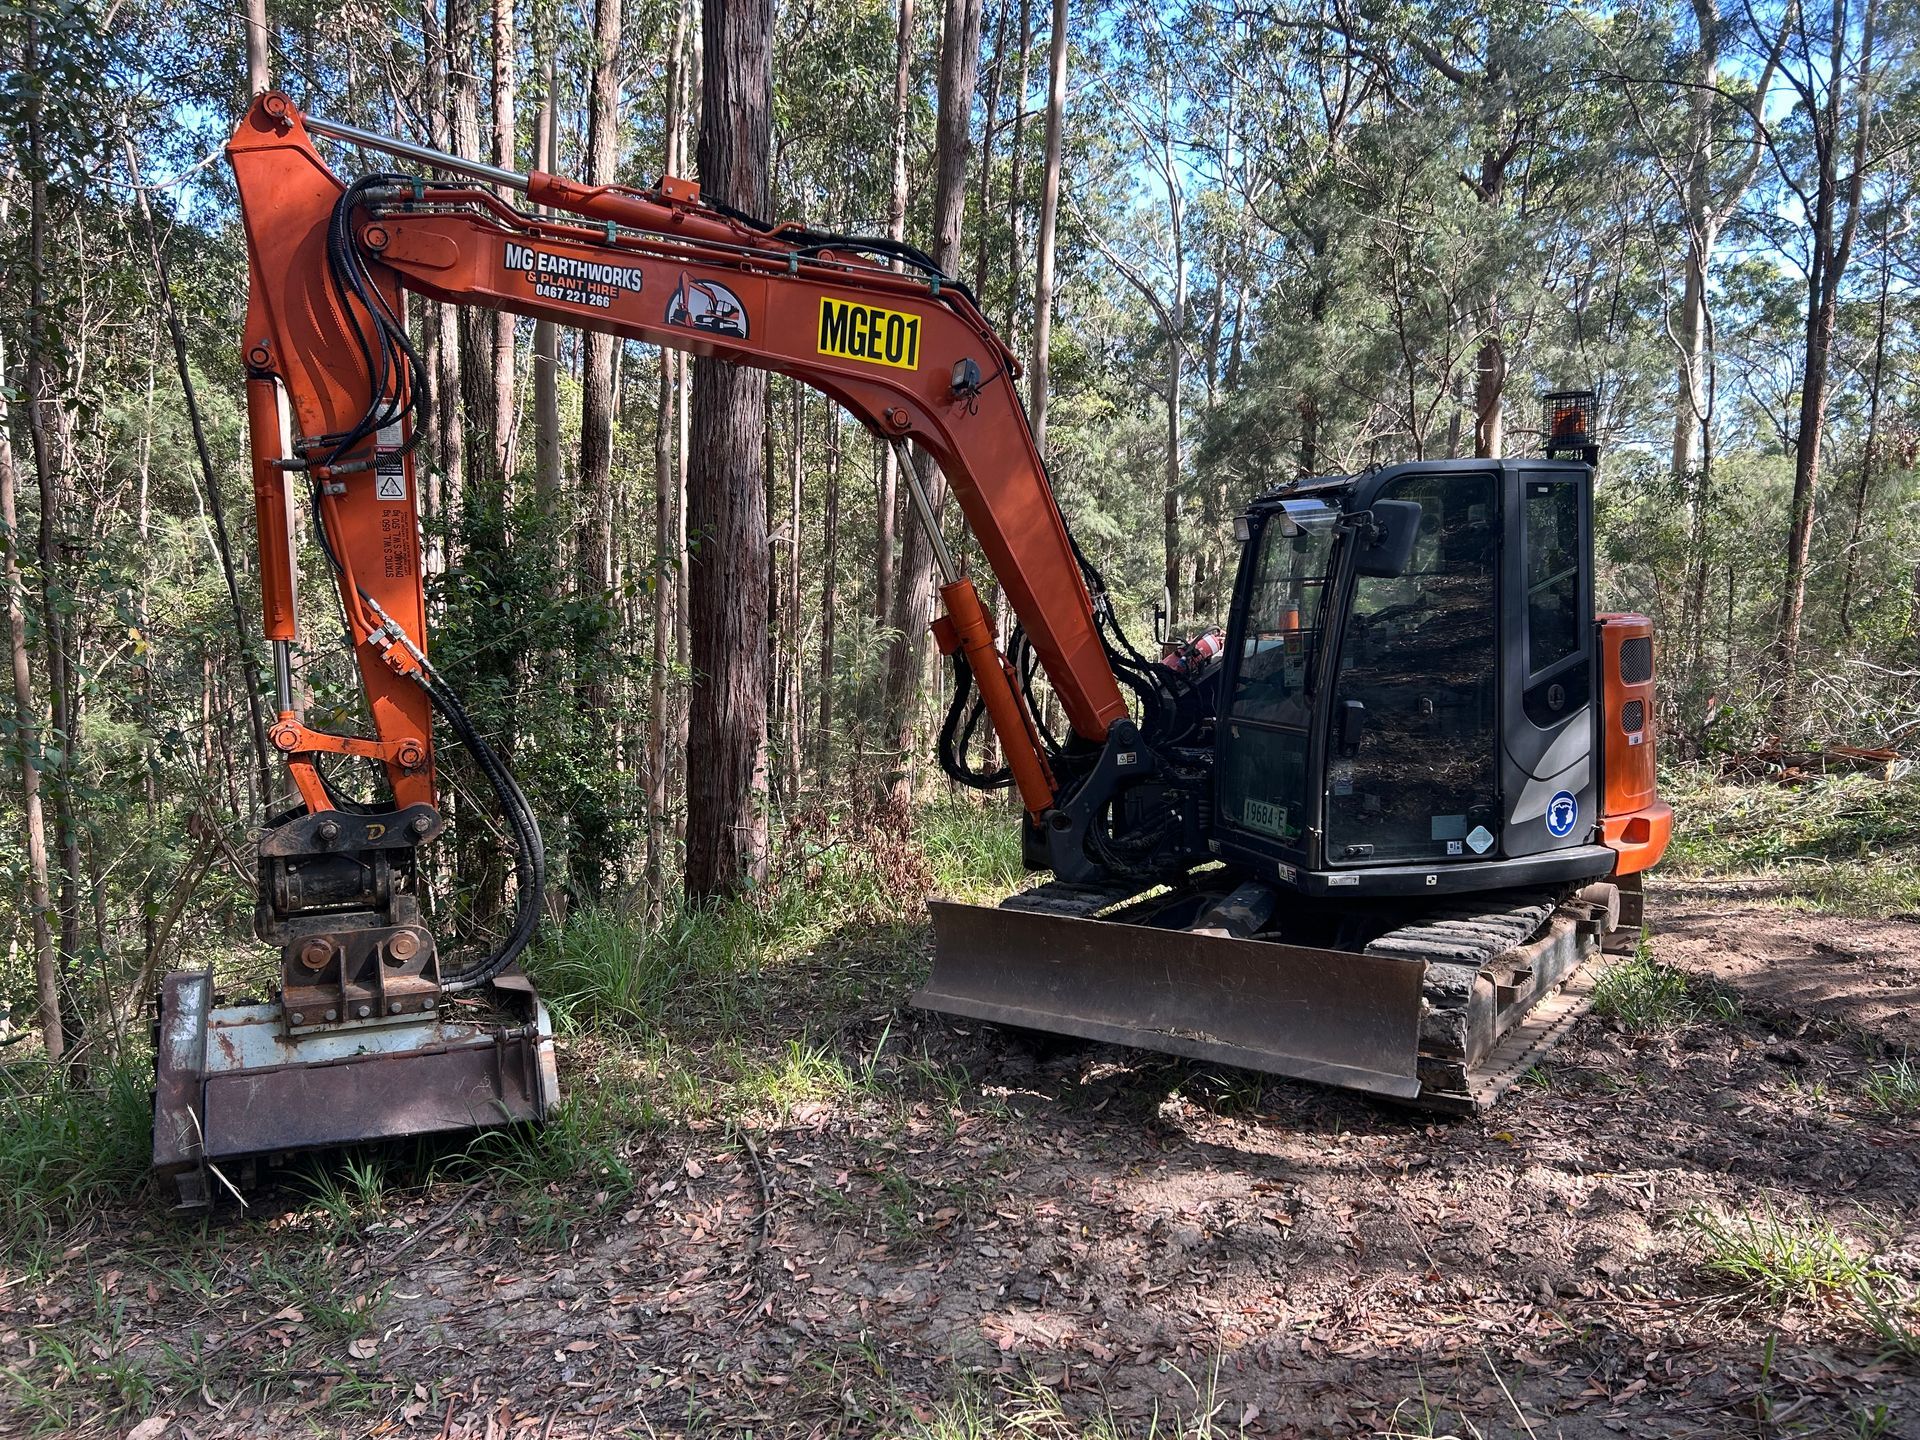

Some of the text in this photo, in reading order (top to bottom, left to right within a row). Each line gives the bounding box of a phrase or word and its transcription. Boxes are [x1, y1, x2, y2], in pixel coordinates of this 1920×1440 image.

[505, 243, 642, 292] MG EARTHWORKS
[527, 271, 618, 298] & PLANT HIRE
[535, 284, 611, 308] 0467 221 266
[820, 301, 919, 366] MGE01
[382, 519, 391, 531] 650
[384, 555, 395, 578] STATIC
